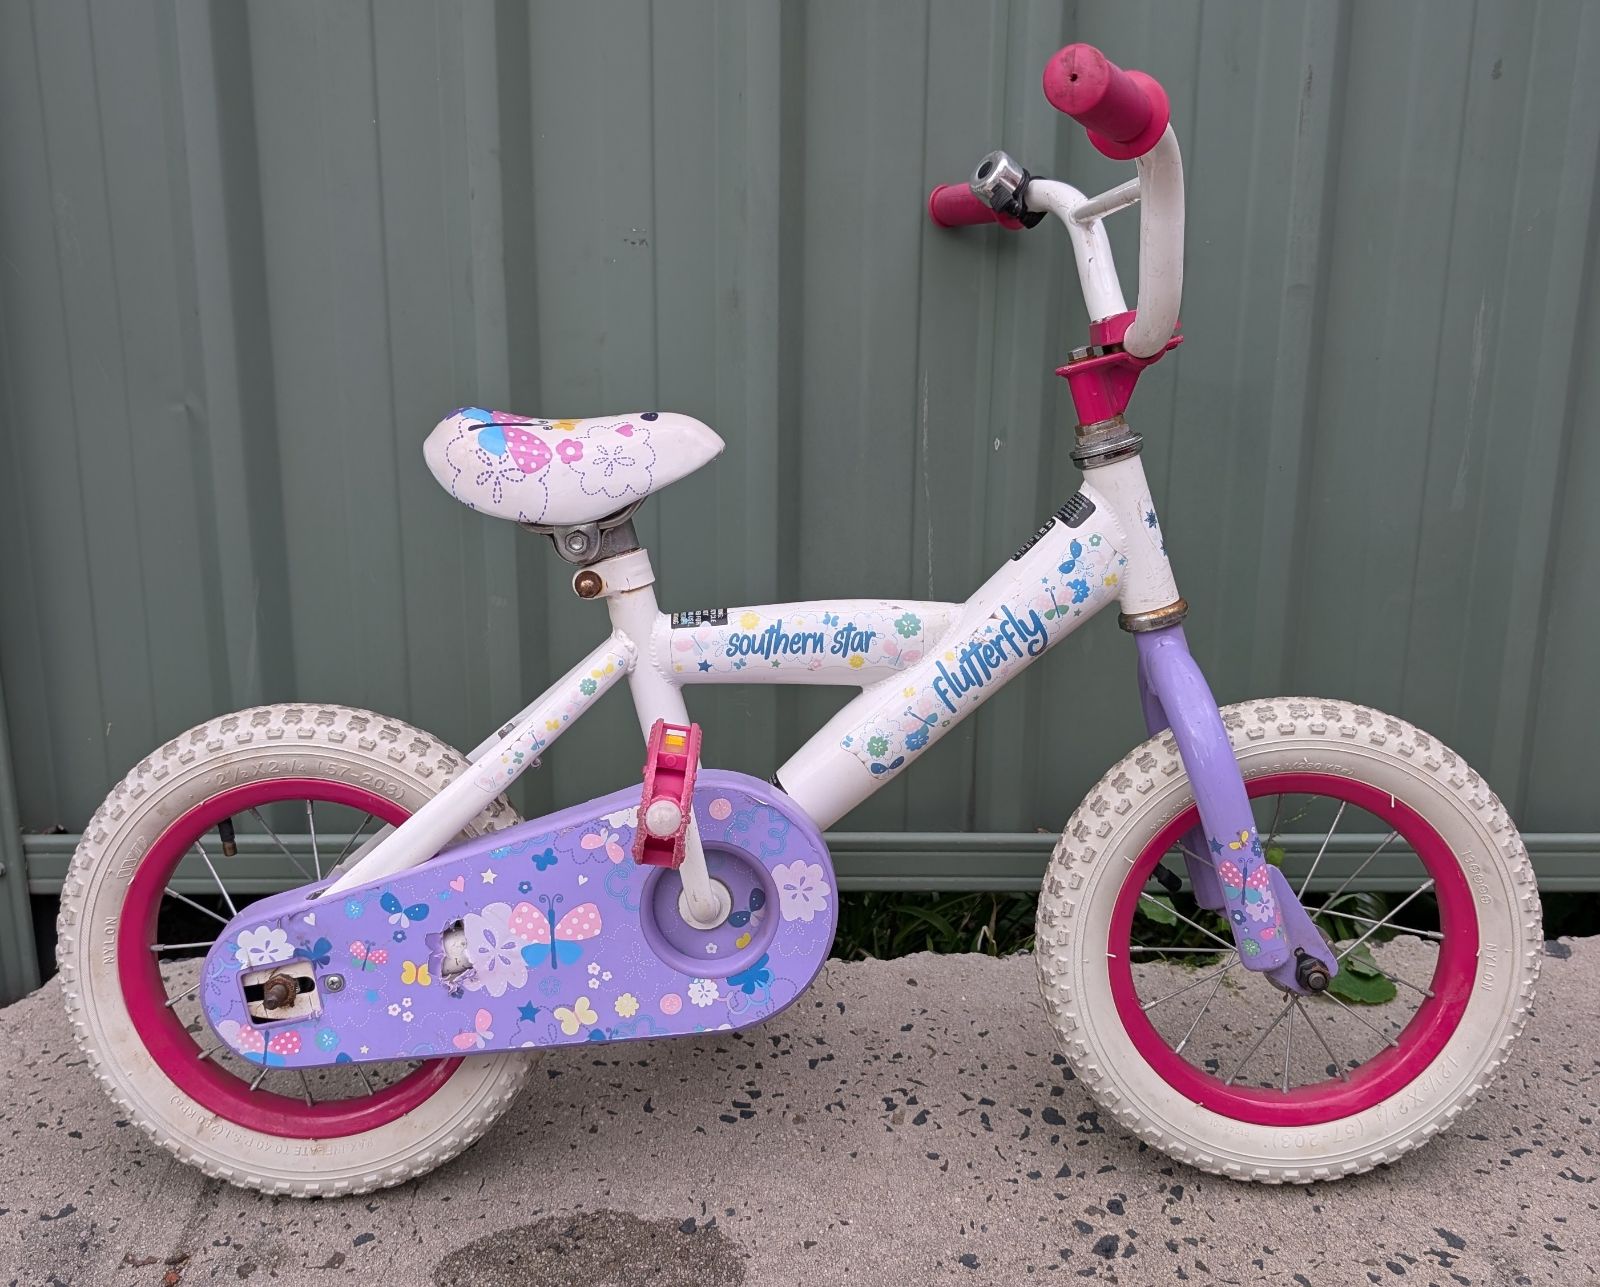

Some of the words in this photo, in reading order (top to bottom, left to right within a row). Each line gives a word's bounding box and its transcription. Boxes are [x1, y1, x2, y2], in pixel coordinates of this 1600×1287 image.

[726, 618, 824, 660] southern
[831, 621, 875, 659] star
[932, 604, 1049, 714] flutterfly
[318, 760, 407, 799] (57-203)
[104, 916, 118, 965] NYLON
[1481, 942, 1498, 993] NYLON
